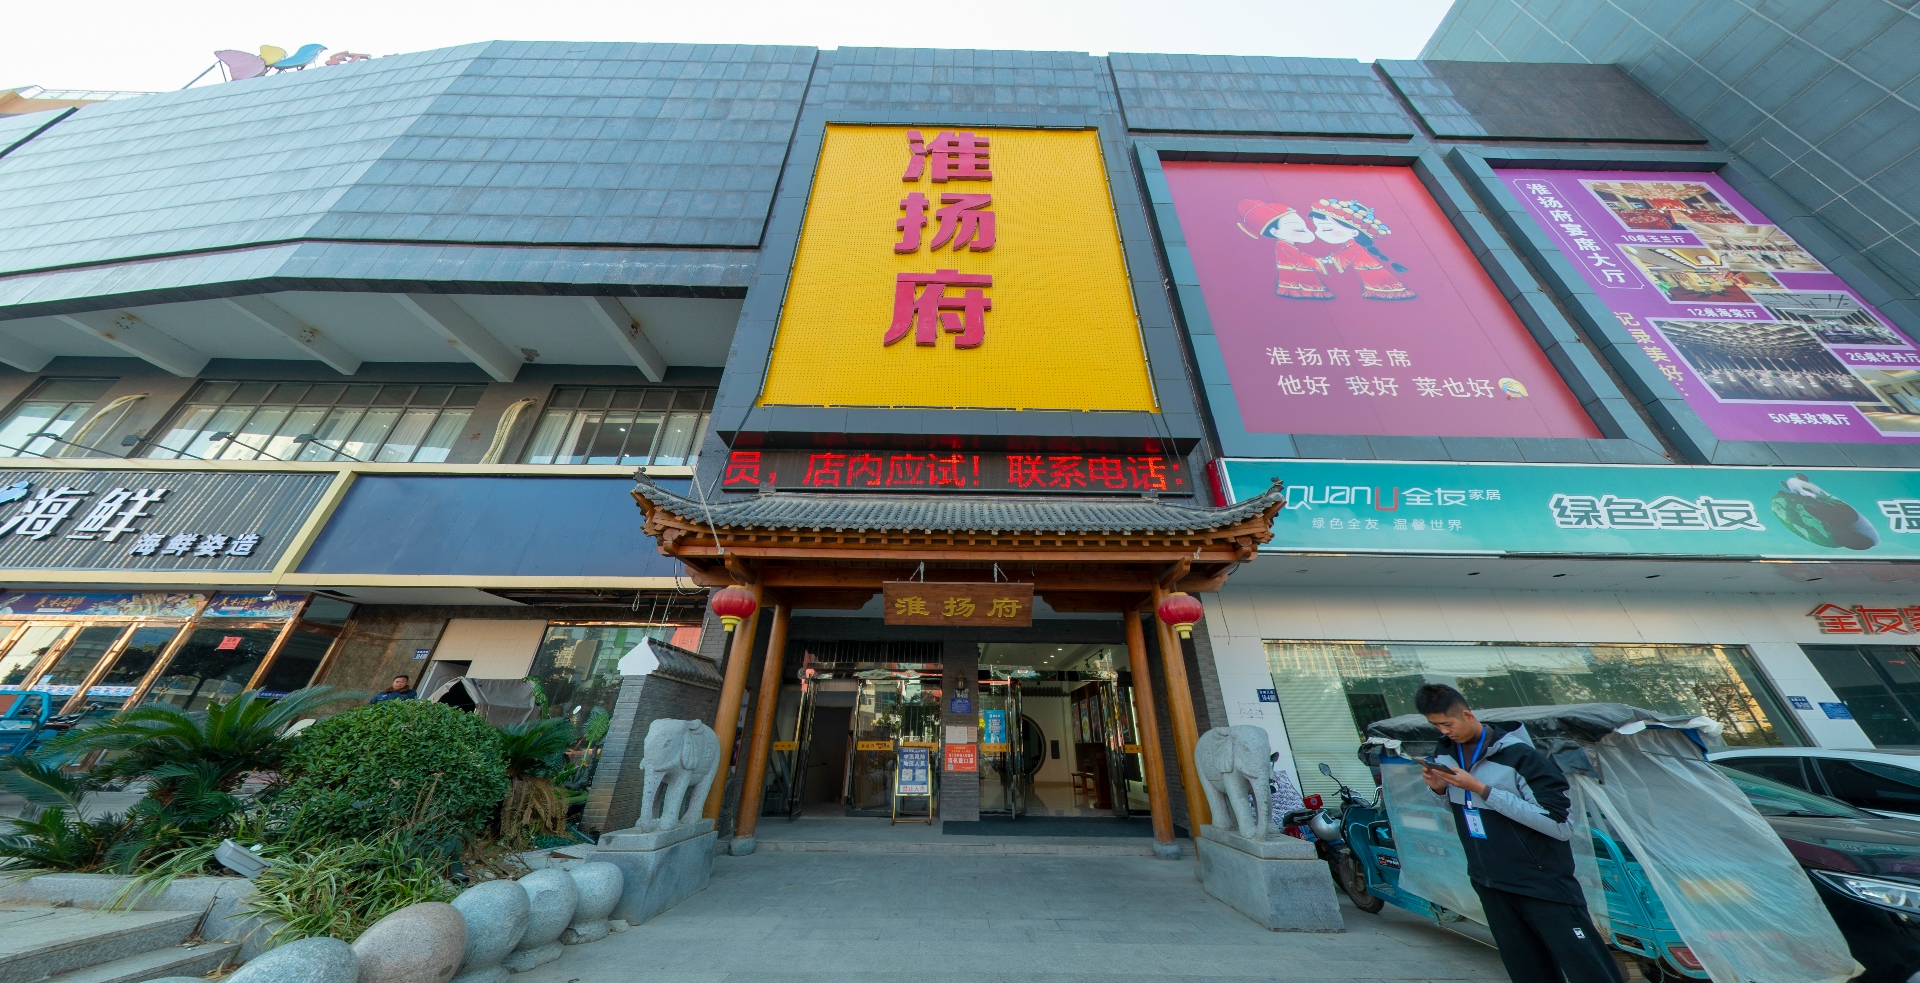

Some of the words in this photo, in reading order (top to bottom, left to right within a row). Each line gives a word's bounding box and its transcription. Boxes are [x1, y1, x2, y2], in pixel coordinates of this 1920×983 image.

[884, 130, 997, 349] 淮扬府
[1526, 183, 1626, 284] 淮扬府宴席大厅
[1621, 234, 1685, 244] 10桌玉兰厅
[1687, 307, 1758, 319] 12桌海棠厅
[1265, 347, 1412, 367] 淮扬府宴席
[1845, 352, 1920, 363] 26桌牡丹厅
[1277, 375, 1331, 396] 他好
[1345, 376, 1399, 397] 我好
[1412, 377, 1495, 398] 菜也好
[1768, 412, 1851, 426] 50桌玫瑰厅
[0, 486, 171, 542] 海鲜
[1551, 494, 1766, 531] 绿色全友
[1312, 518, 1379, 530] 绿色全友
[1393, 518, 1463, 532] 温馨世界
[129, 533, 261, 557] 海鲜姿造
[894, 595, 1023, 618] 淮扬府
